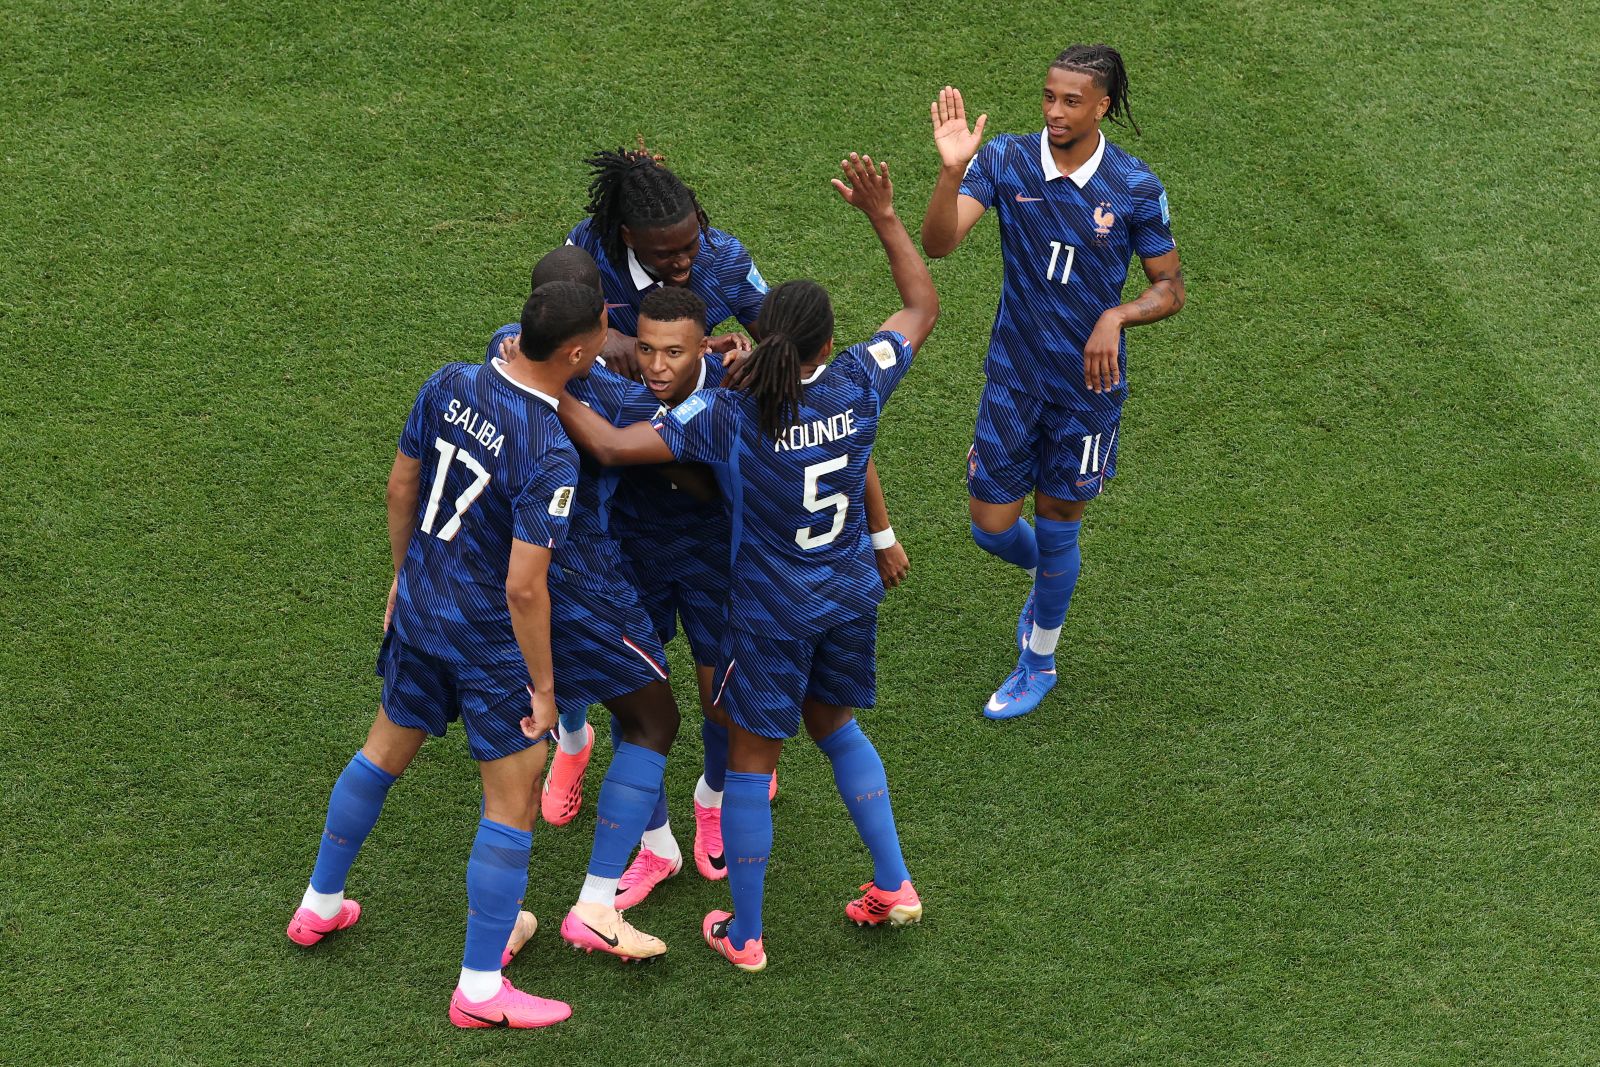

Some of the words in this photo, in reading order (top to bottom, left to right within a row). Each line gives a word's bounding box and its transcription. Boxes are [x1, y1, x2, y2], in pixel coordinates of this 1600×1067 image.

[1046, 240, 1075, 285] 11
[443, 398, 505, 458] SALIBA
[1080, 432, 1102, 475] 11
[420, 436, 492, 542] 17
[794, 453, 850, 551] 5
